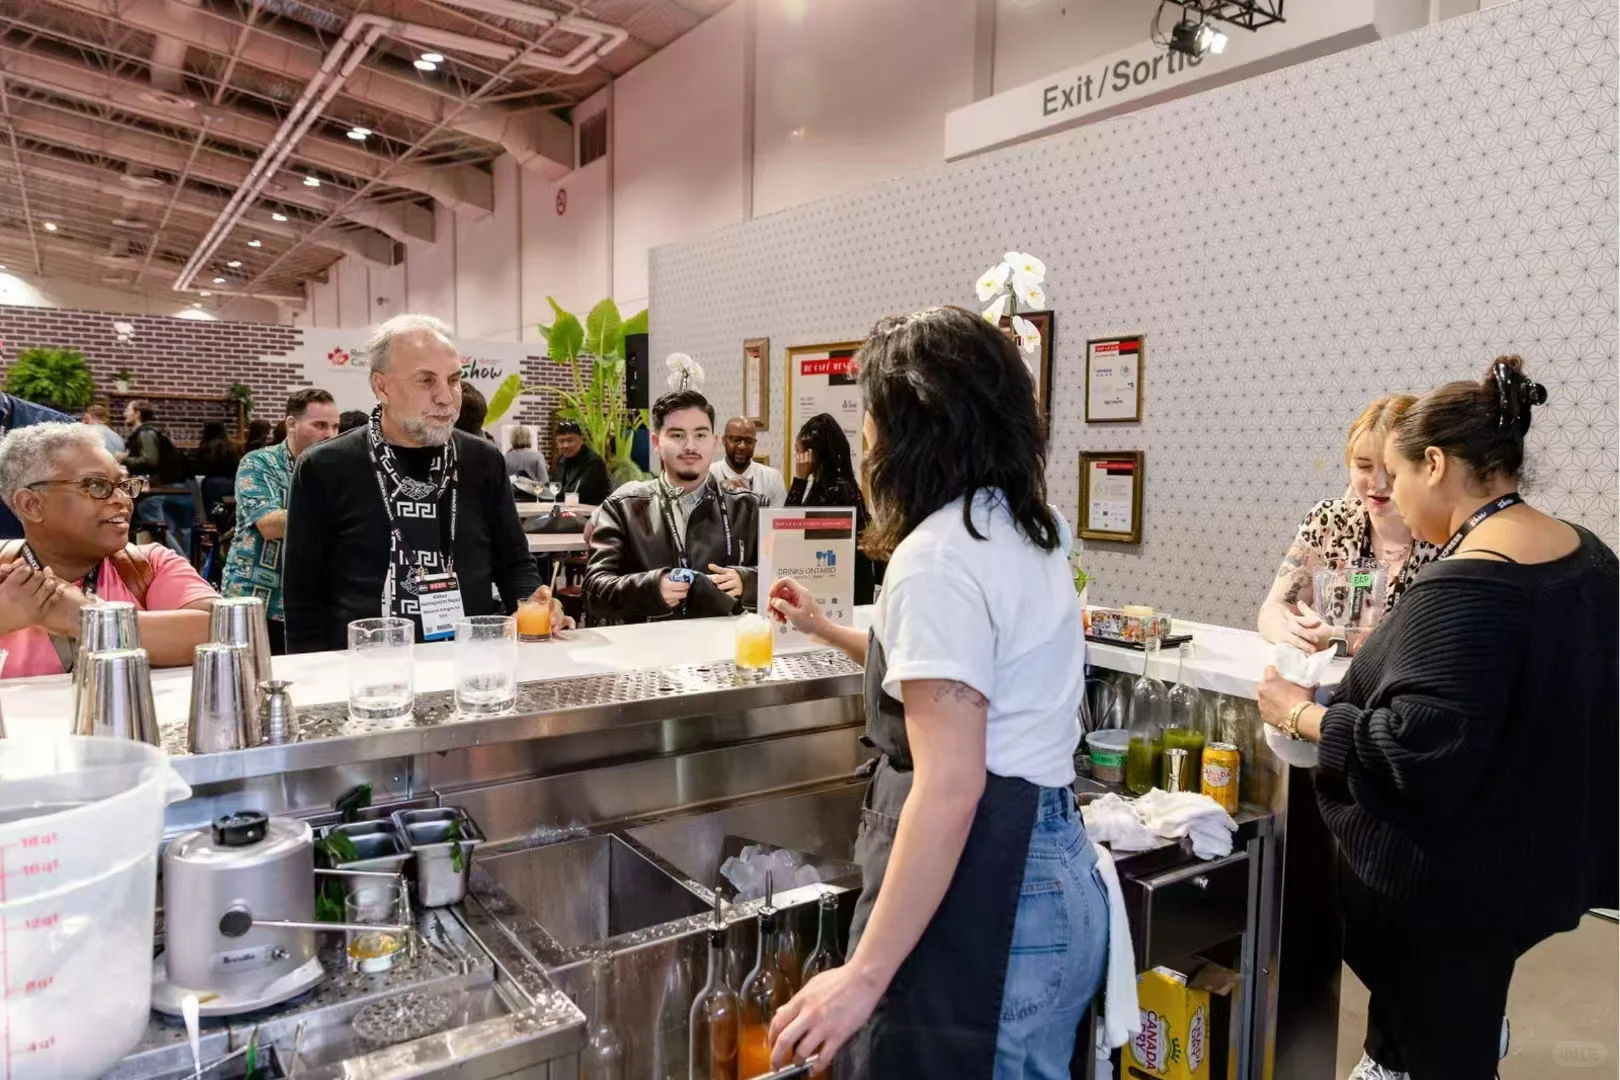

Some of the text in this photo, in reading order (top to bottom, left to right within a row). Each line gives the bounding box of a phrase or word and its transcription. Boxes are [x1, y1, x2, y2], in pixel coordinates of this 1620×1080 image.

[777, 567, 837, 576] DRINKS ONTARIO
[1146, 1010, 1158, 1070] CANADA
